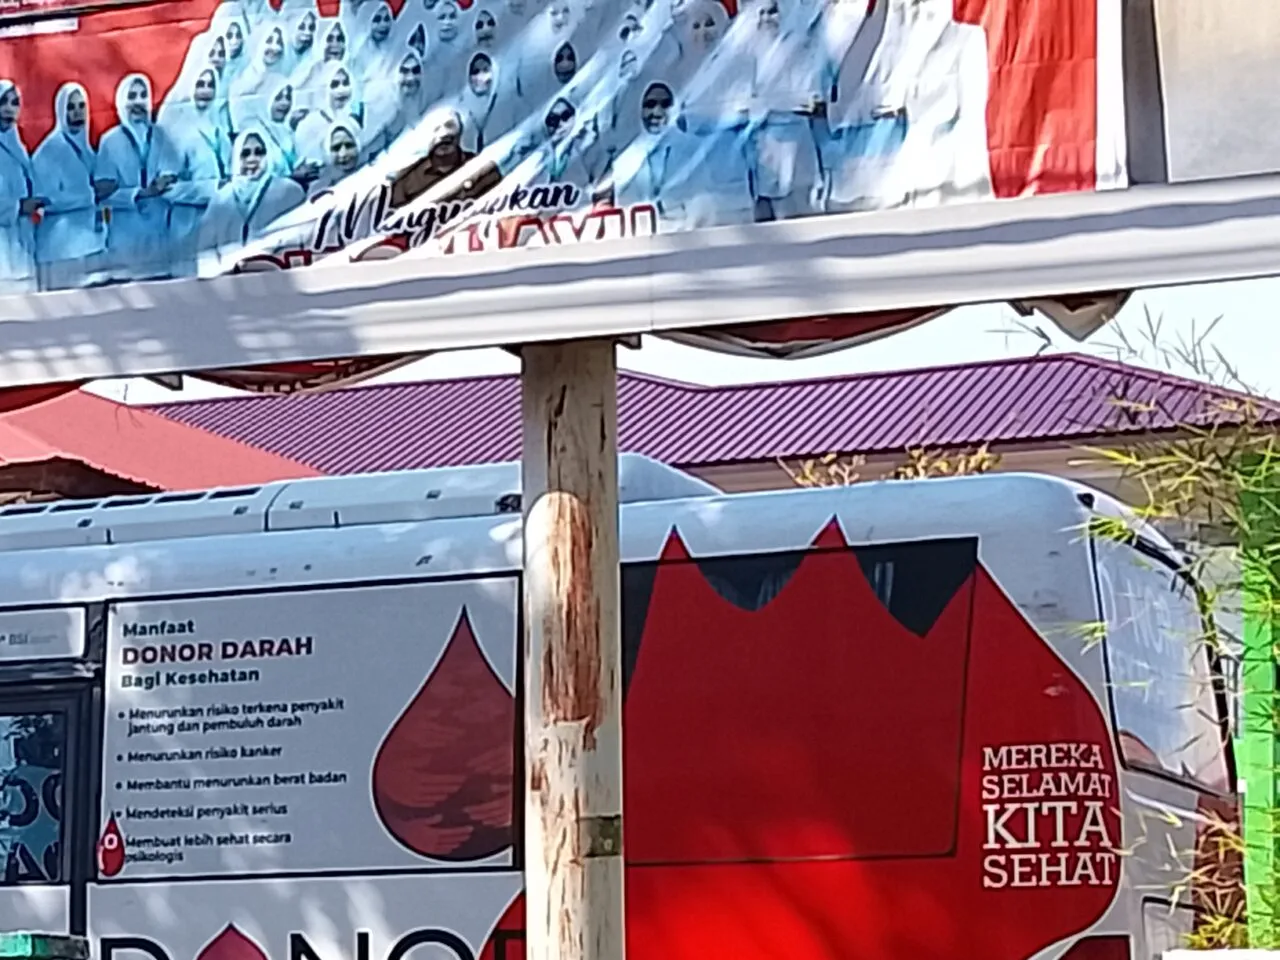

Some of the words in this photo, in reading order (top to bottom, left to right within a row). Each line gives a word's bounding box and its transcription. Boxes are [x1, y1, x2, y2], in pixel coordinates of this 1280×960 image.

[123, 620, 194, 637] Manfaat
[122, 643, 213, 665] DONOR
[221, 636, 313, 660] DARAH
[166, 668, 259, 686] Kesehatan
[129, 706, 204, 720] Menurunkan
[206, 703, 239, 717] risiko
[242, 702, 288, 714] terkena
[291, 698, 344, 714] penyakit
[128, 720, 174, 737] jantung
[177, 718, 199, 732] dan
[202, 717, 264, 733] pembuluh
[267, 715, 302, 727] darah
[127, 749, 202, 763] Menurunkan
[205, 747, 238, 759] risiko
[240, 746, 282, 757] kanker
[982, 743, 1105, 771] MEREKA
[193, 775, 270, 788] menurunkan
[273, 773, 306, 785] berat
[308, 771, 347, 783] badan
[982, 771, 1112, 799] SELAMAT
[982, 801, 1113, 850] KITA
[983, 852, 1116, 889] SEHAT
